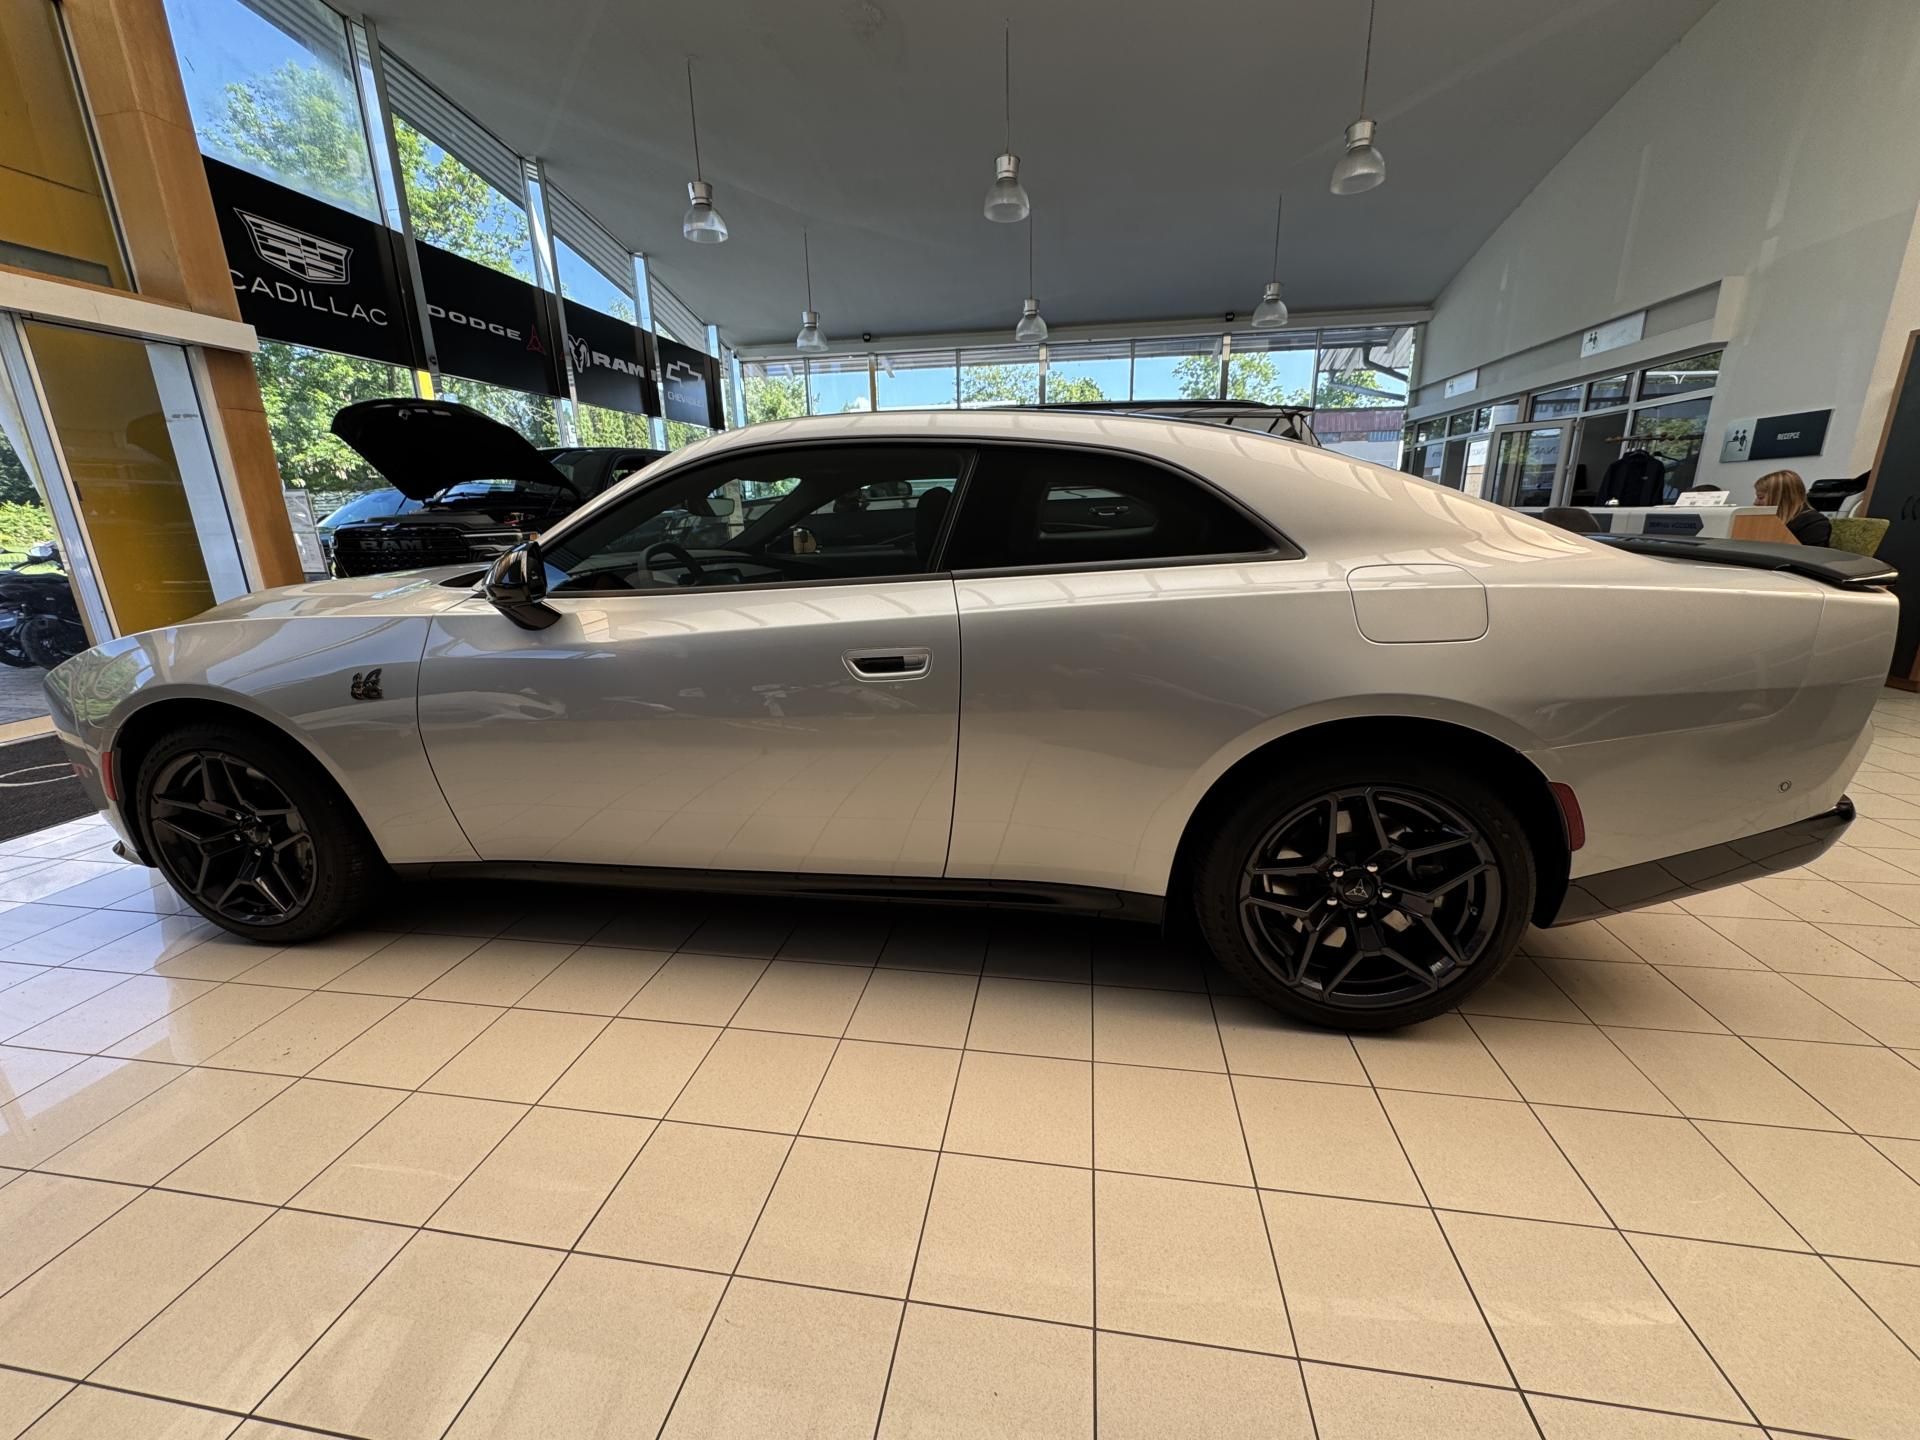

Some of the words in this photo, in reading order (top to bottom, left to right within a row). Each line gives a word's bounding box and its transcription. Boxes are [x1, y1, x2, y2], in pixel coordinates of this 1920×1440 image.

[230, 269, 388, 326] CADILLAC
[426, 304, 522, 340] DODGE
[592, 351, 646, 378] RAM
[359, 540, 423, 552] RAM
